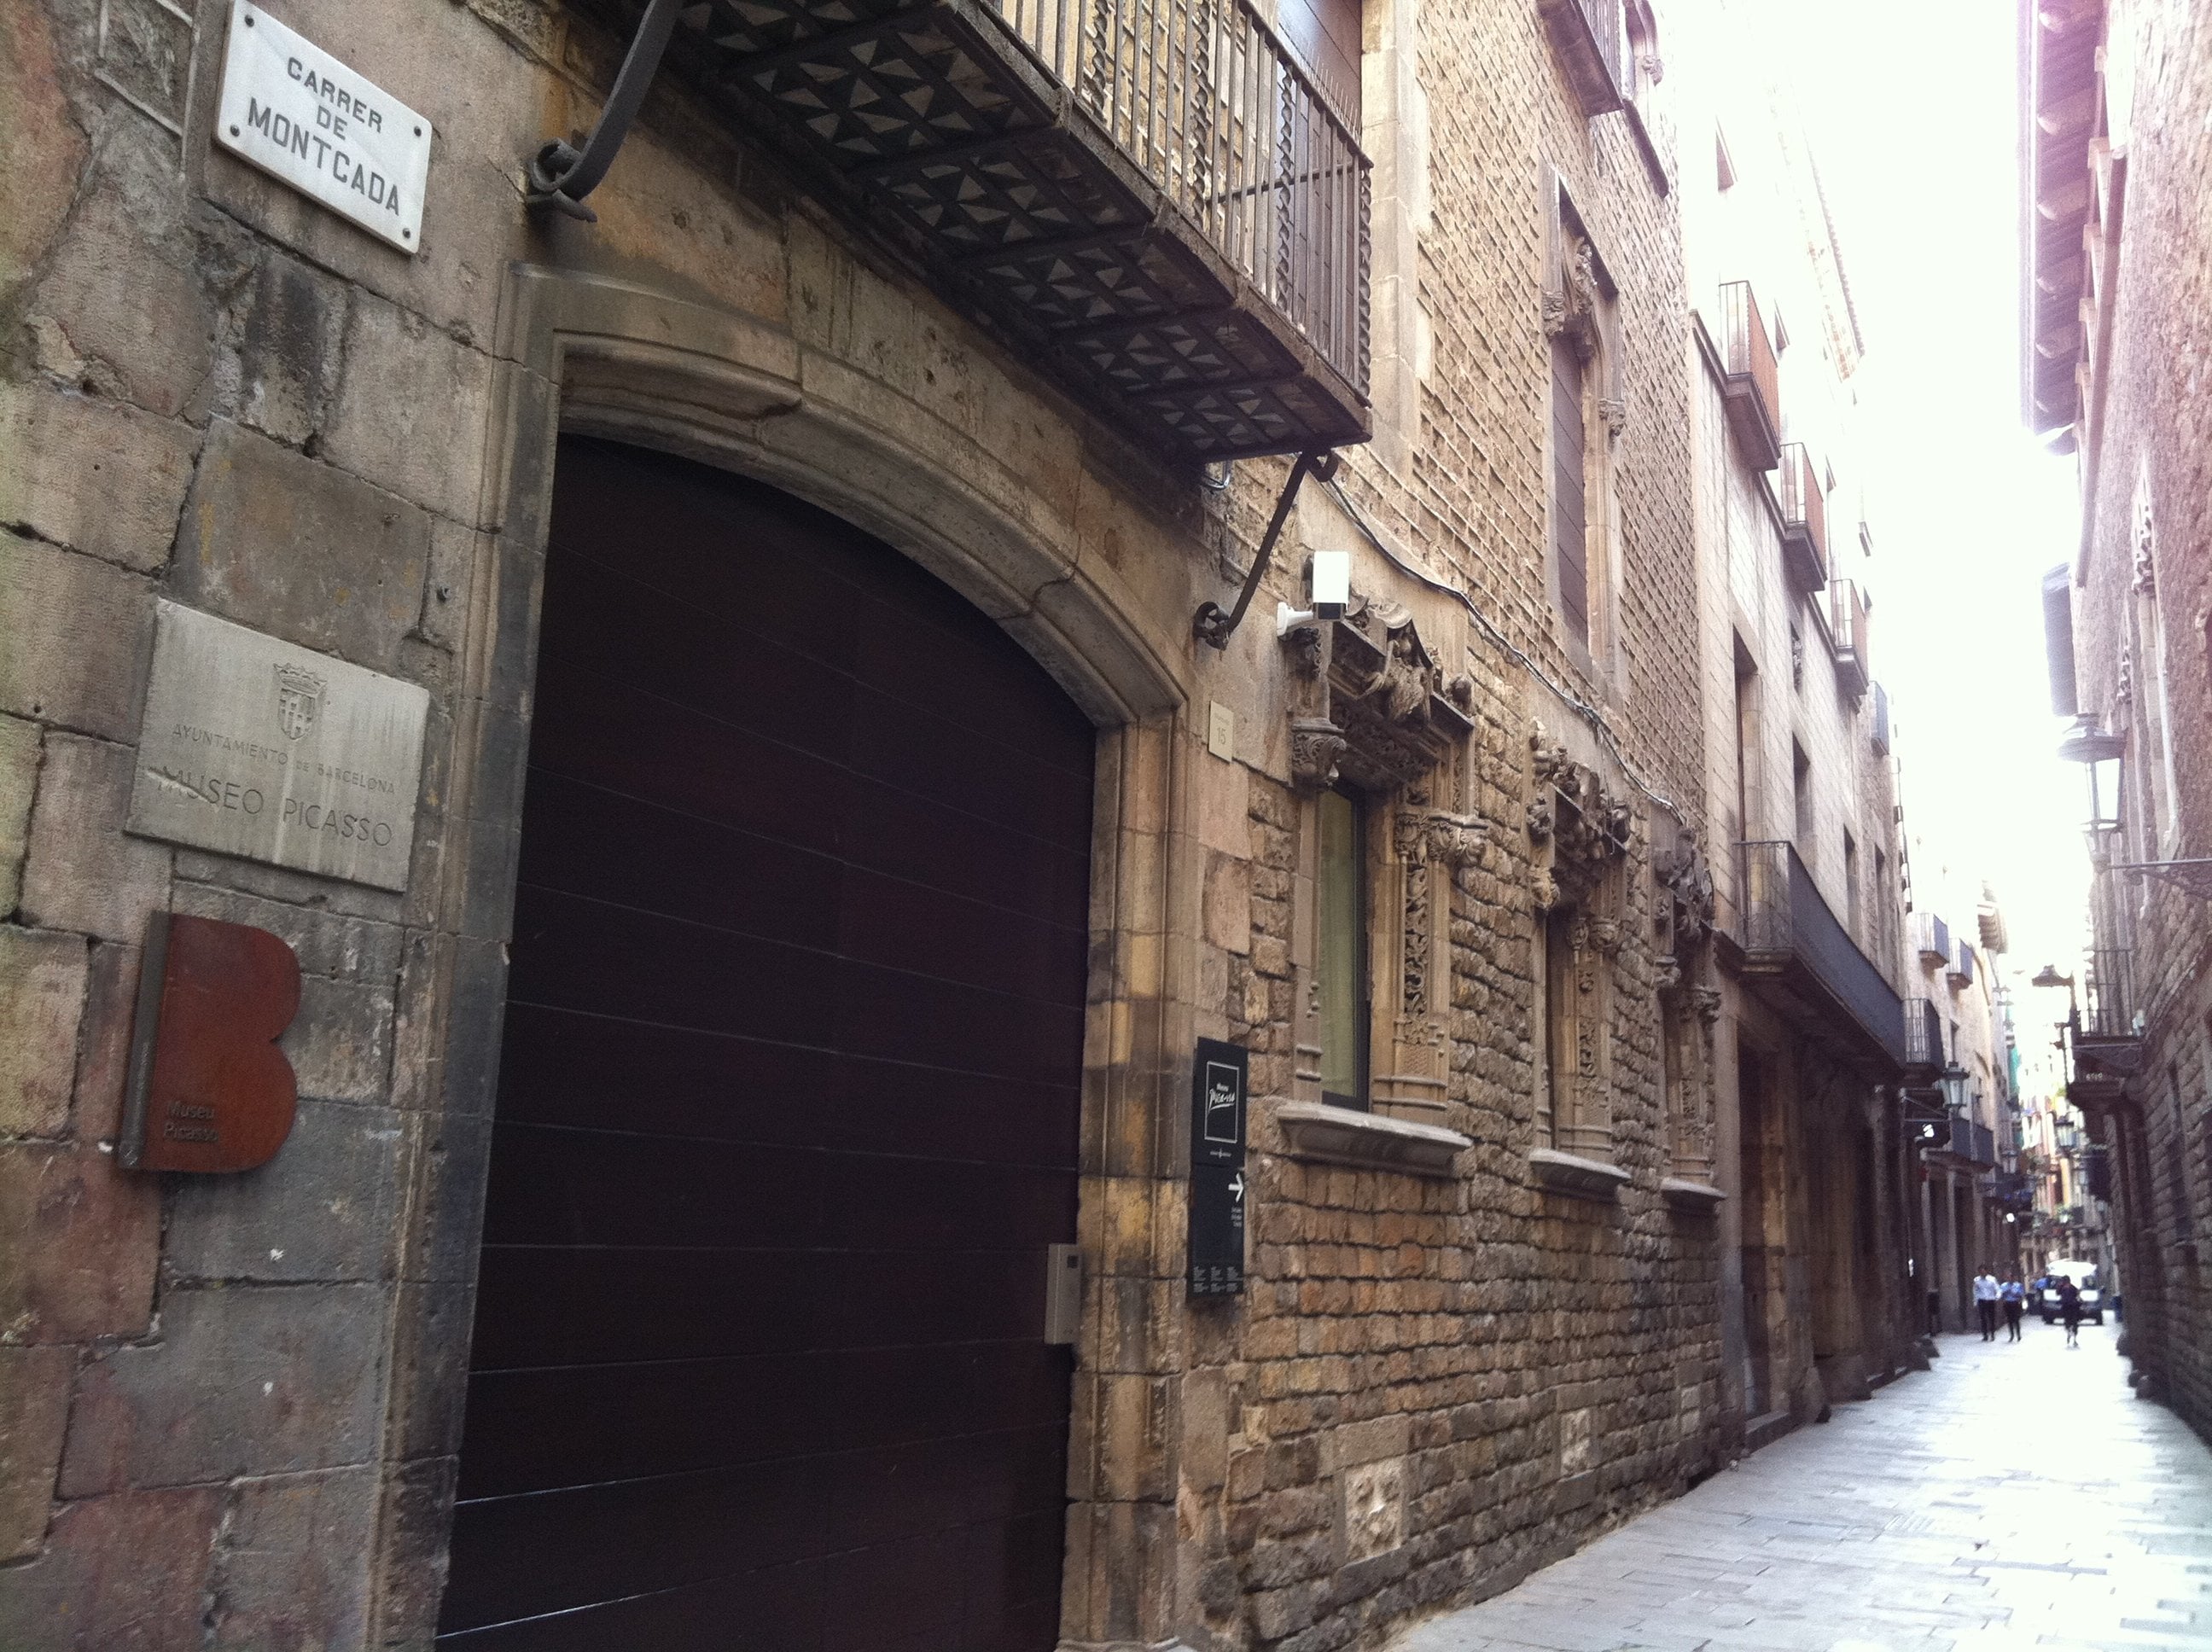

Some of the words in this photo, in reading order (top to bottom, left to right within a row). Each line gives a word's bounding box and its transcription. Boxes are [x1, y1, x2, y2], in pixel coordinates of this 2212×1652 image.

[286, 56, 383, 134] CARRER
[316, 105, 348, 141] DE
[247, 96, 399, 217] MONTCADA
[172, 724, 288, 765] AYUNTAMIENTO
[317, 763, 395, 794] BARCELONA
[282, 797, 393, 846] PICASSO
